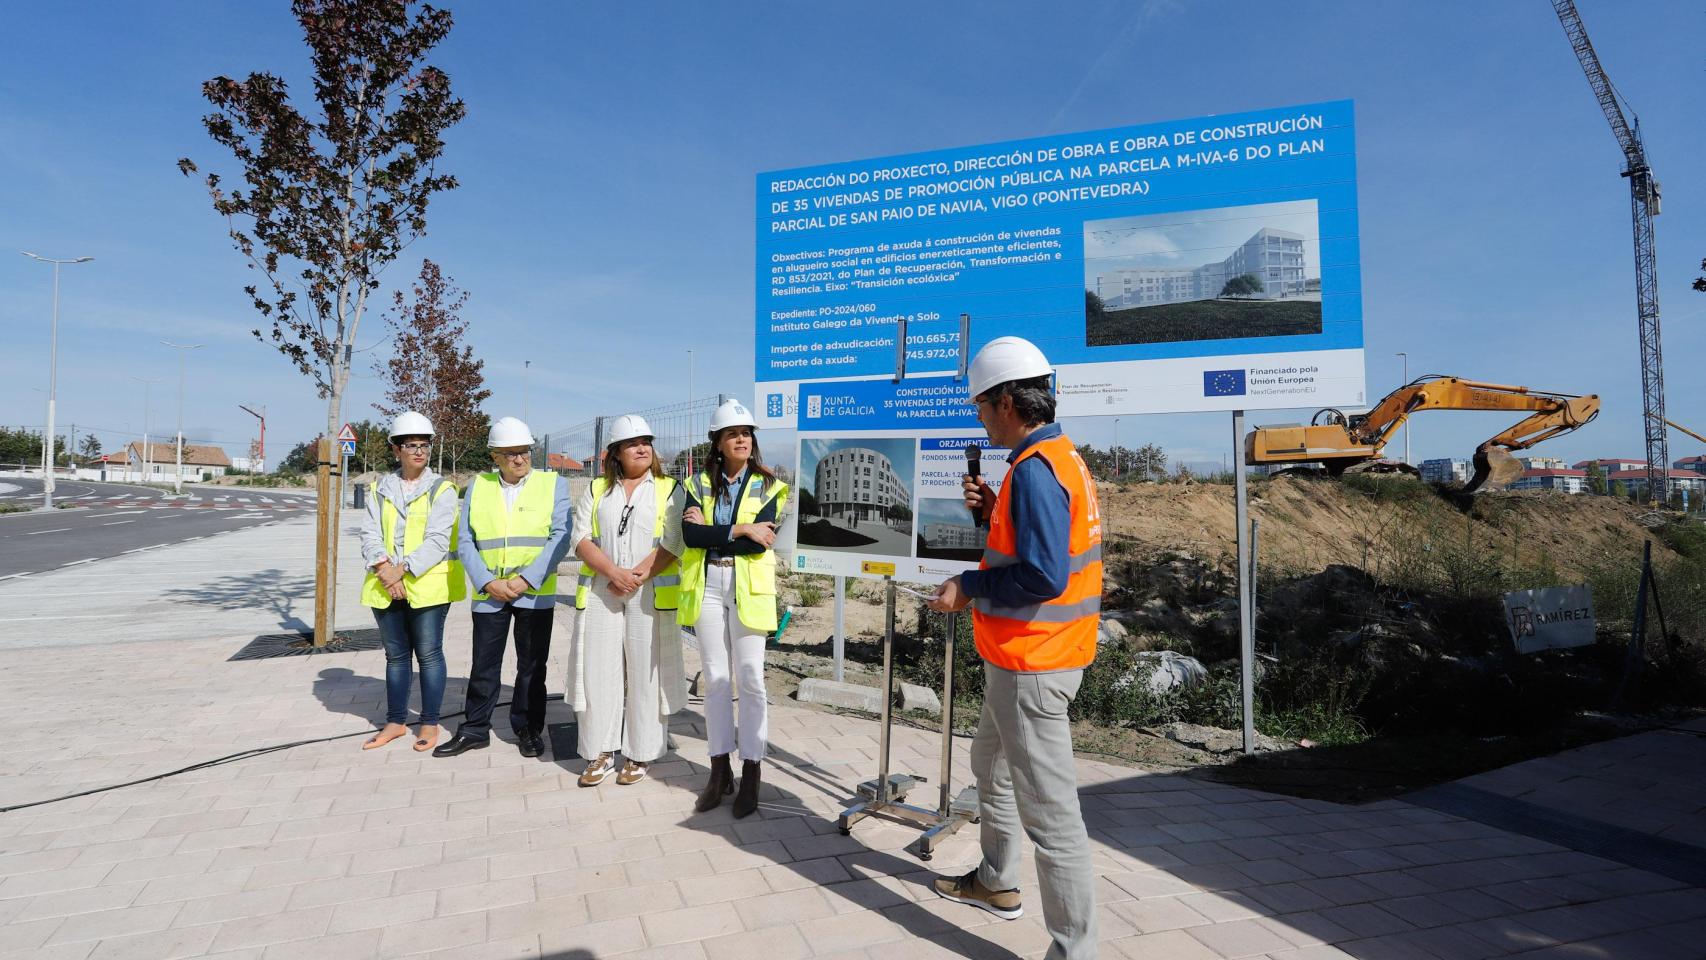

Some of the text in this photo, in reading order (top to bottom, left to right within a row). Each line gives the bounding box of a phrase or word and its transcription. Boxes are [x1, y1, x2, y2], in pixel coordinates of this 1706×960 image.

[771, 114, 1323, 193] REDACCIÓN DO PROXECTO, DIRECCIÓN DE OBRA E OBRA DE CONSTRUCIÓN
[772, 139, 1324, 214] DE 35 VIVENDAS DE PROMOCIÓN PÚBLICA NA PARCELA M-IVA-6 DO PLAN
[771, 180, 1150, 233] PARCIAL DE SAN PAIO DE NAVIA, VIGO (PONTEVEDRA)
[771, 226, 1062, 263] Obxectivos: Programa de axuda á construción de vivendas
[771, 239, 1062, 274] en alugueiro social en edificios enerxeticamente eficientes,
[771, 276, 786, 285] RD
[788, 271, 834, 284] 853/2021,
[837, 270, 851, 279] do
[854, 267, 875, 278] Plan
[878, 266, 891, 275] de
[895, 259, 966, 274] Recuperación,
[970, 252, 1051, 268] Transformación
[771, 284, 823, 297] Resiliencia.
[825, 282, 849, 292] Eixo:
[771, 303, 876, 321] Expediente: PO-2024/060
[771, 321, 810, 332] Instituto
[812, 318, 848, 329] Galego
[849, 317, 862, 326] da
[908, 314, 915, 322] e
[916, 311, 940, 321] Solo
[771, 343, 808, 354] Importe
[810, 342, 823, 351] de
[825, 337, 895, 350] adxudicación:
[771, 358, 808, 369] Importe
[810, 356, 823, 366] da
[825, 354, 858, 365] axuda:
[1250, 365, 1319, 376] Financiado pola
[1250, 376, 1314, 386] Unión Europea
[896, 385, 954, 397] CONSTRUCIÓN
[1250, 386, 1317, 396] NextGenerationEU
[824, 396, 856, 406] XUNTA
[883, 396, 970, 408] 35 VIVENDAS DE PRO
[823, 406, 875, 416] DE GALICIA
[896, 408, 979, 418] NA PARCELA M-IVA-
[1535, 607, 1591, 625] RAMÍREZ
